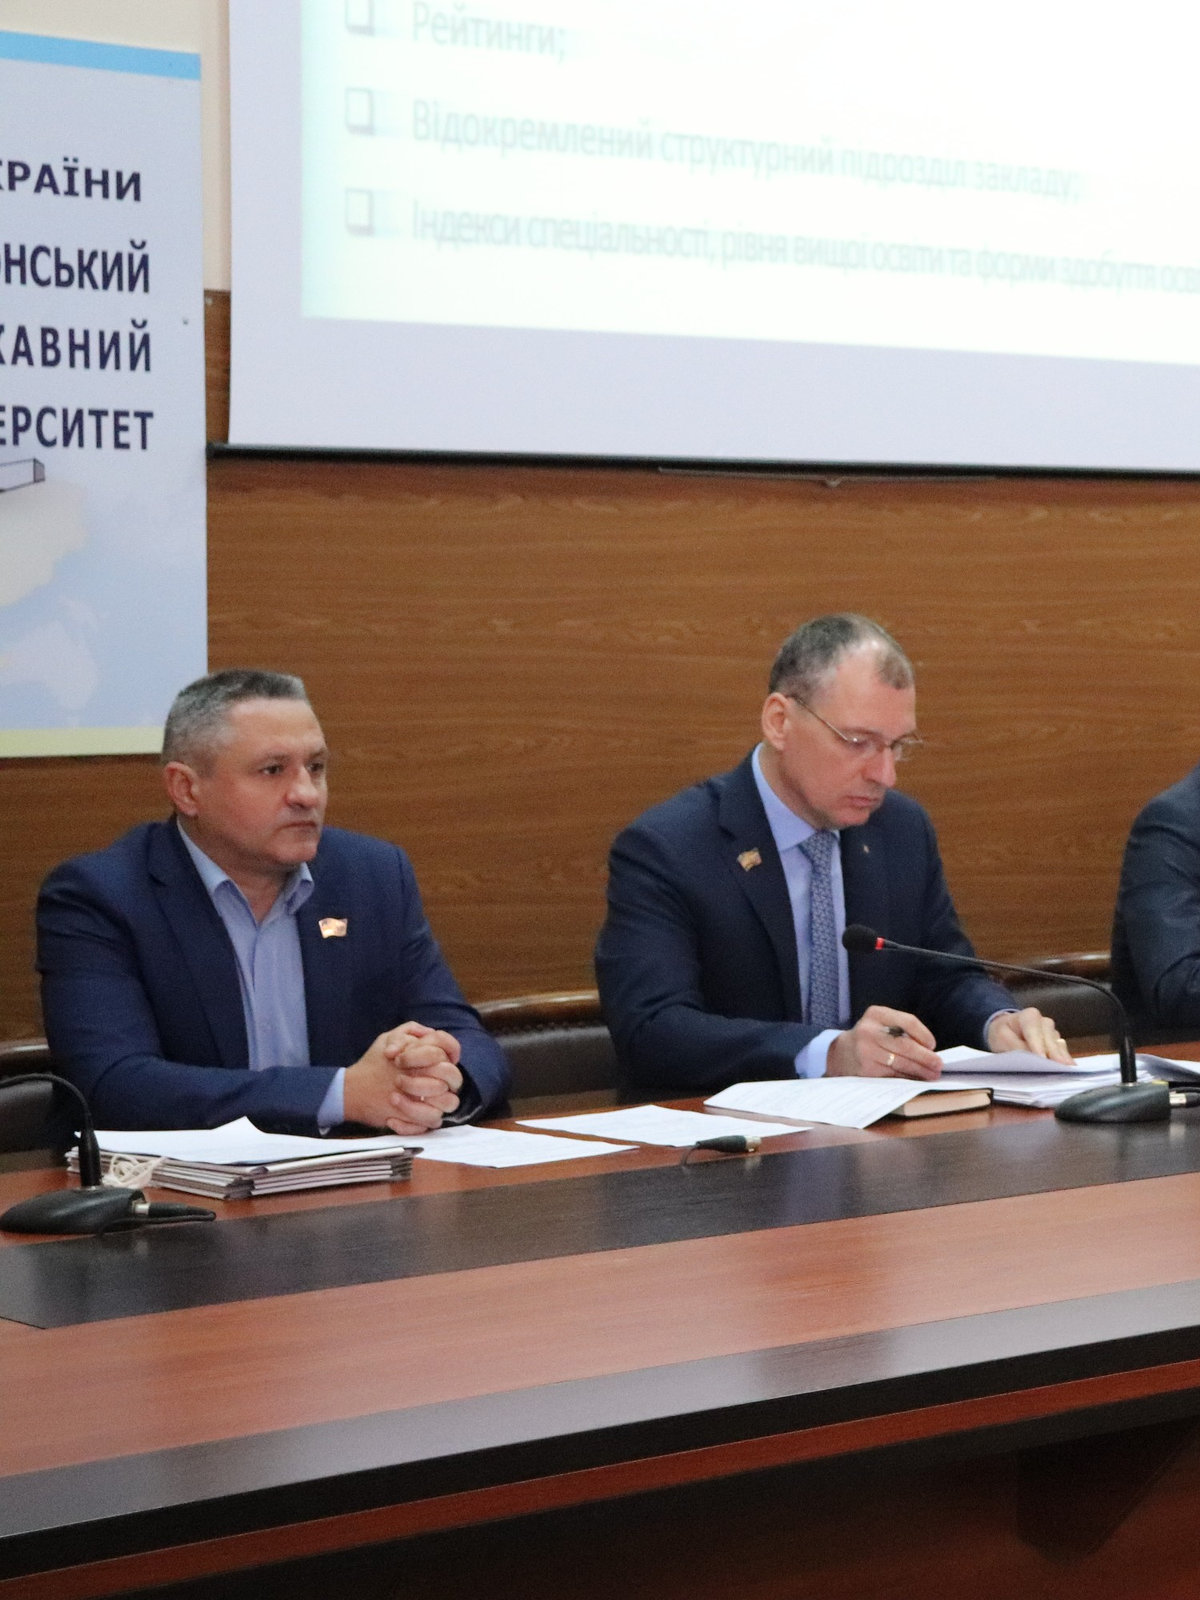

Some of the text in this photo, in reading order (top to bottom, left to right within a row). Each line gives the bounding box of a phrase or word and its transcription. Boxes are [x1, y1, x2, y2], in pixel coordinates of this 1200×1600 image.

[412, 1, 567, 63] Рейтинги;
[411, 99, 653, 160] Відокремлений
[660, 131, 834, 179] структурний
[0, 157, 141, 202] РАЇНИ
[412, 198, 521, 250] Індекси
[722, 222, 788, 269] рівня
[0, 240, 150, 293] НСЬКИЙ
[0, 319, 151, 373] АВНИЙ
